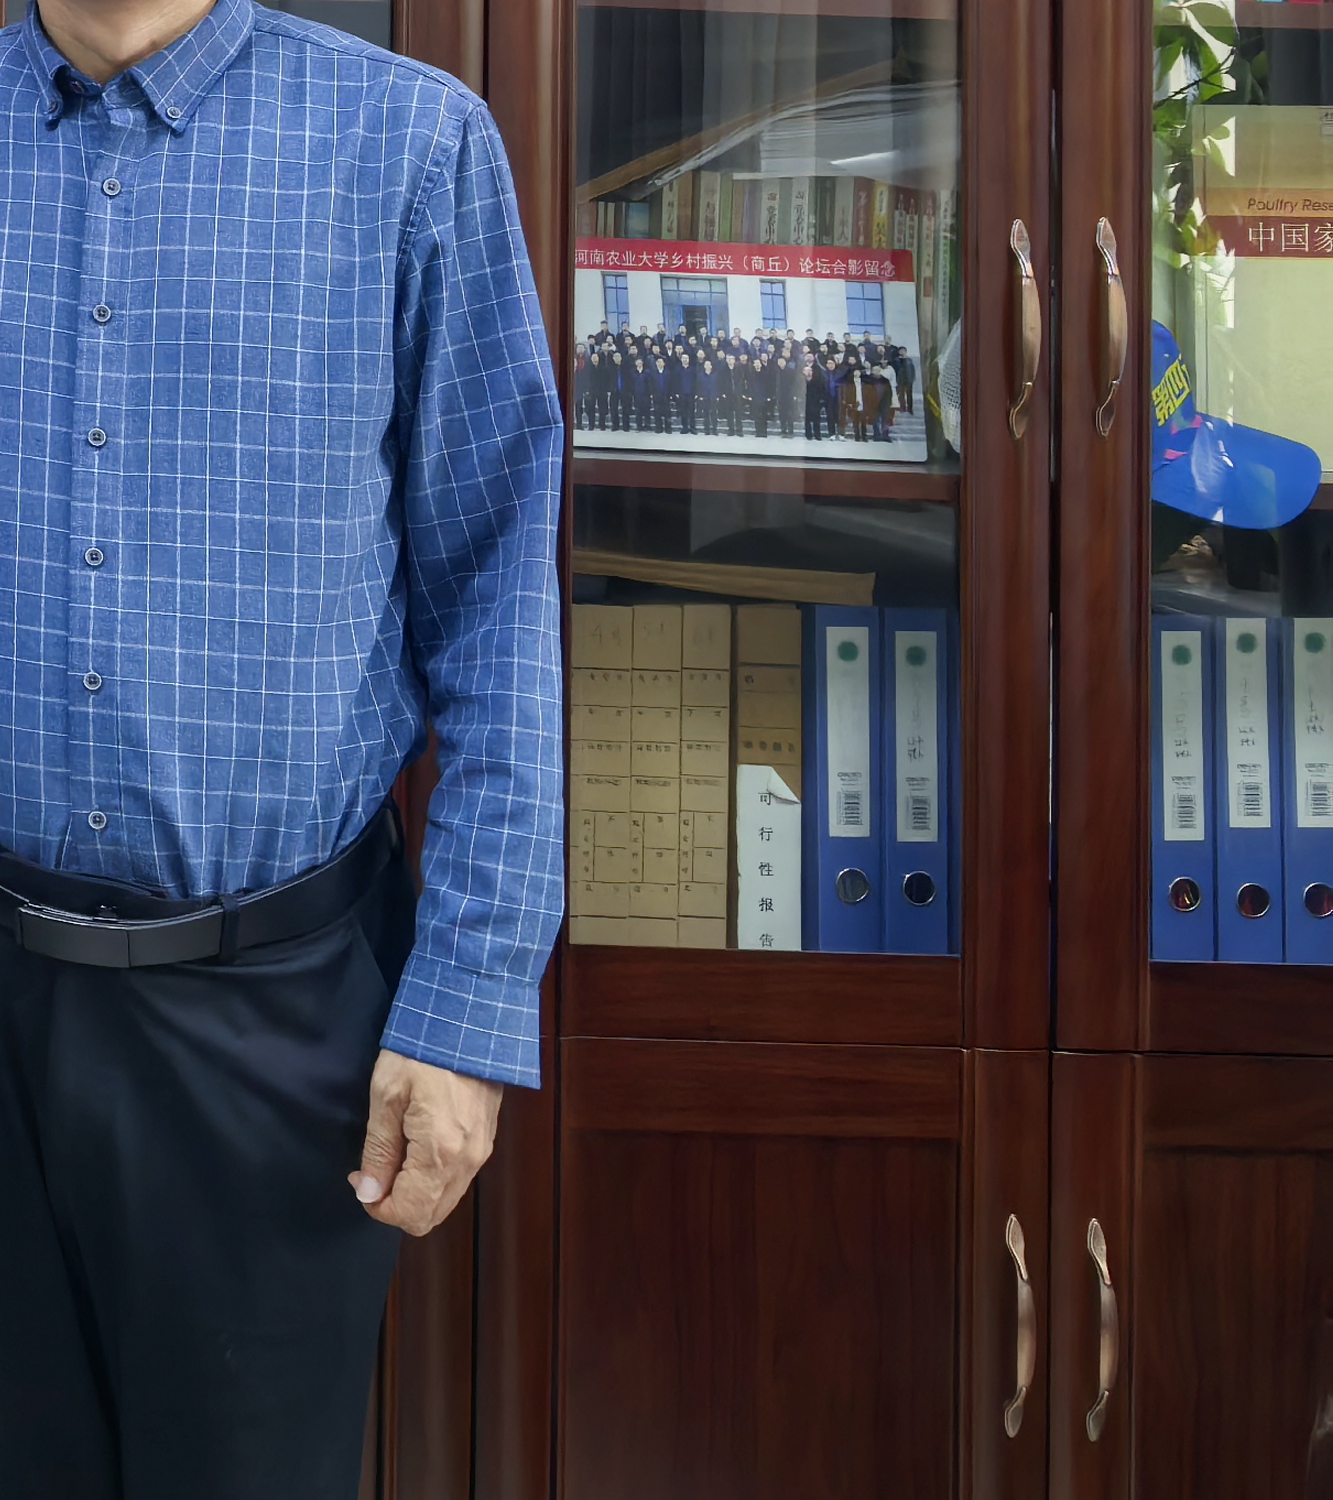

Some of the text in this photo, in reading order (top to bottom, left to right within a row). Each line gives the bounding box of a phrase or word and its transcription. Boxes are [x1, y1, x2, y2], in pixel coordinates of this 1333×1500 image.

[1247, 197, 1299, 213] Poultry
[574, 248, 896, 279] 河南农业大学乡村振兴（商丘）论坛合影留念
[758, 790, 774, 948] 可行性报告
